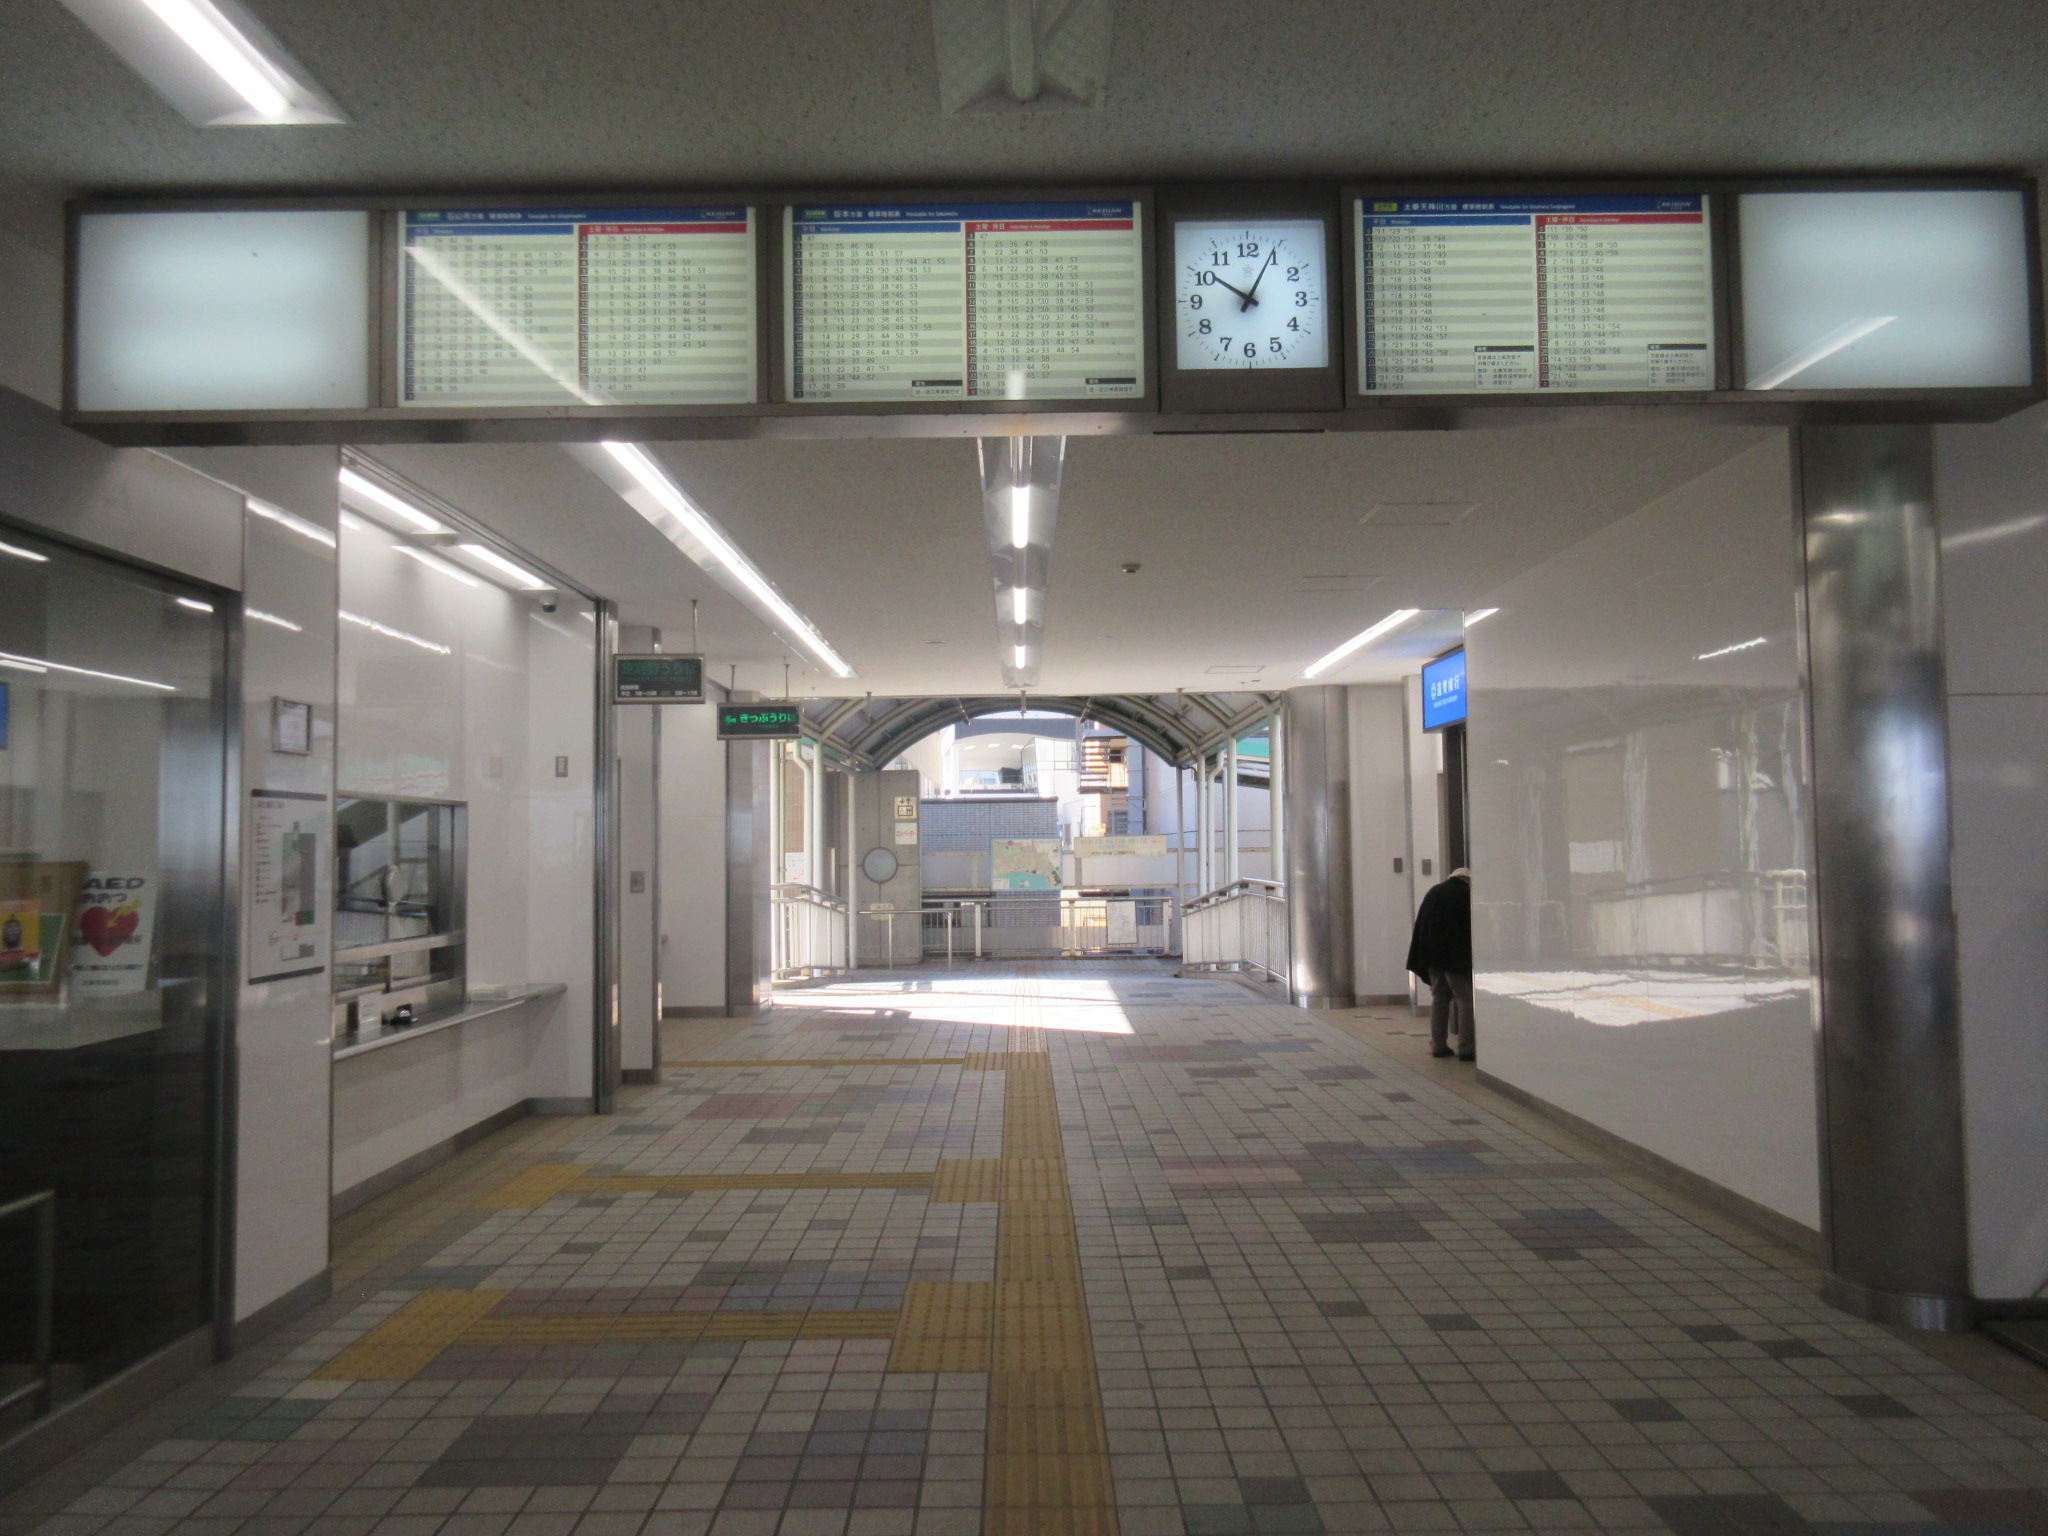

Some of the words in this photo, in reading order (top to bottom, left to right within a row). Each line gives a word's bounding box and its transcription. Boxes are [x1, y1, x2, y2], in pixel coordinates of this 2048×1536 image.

[1238, 242, 1259, 258] 12
[1272, 250, 1278, 265] 1
[1212, 252, 1230, 266] 11
[1195, 271, 1215, 286] 10
[1287, 267, 1299, 282] 2
[1191, 295, 1202, 310] 9
[1296, 291, 1307, 307] 3
[1199, 319, 1211, 334] 8
[1287, 317, 1299, 331] 4
[1220, 337, 1232, 351] 7
[1244, 343, 1256, 358] 6
[1270, 337, 1282, 352] 5
[86, 877, 144, 889] AED
